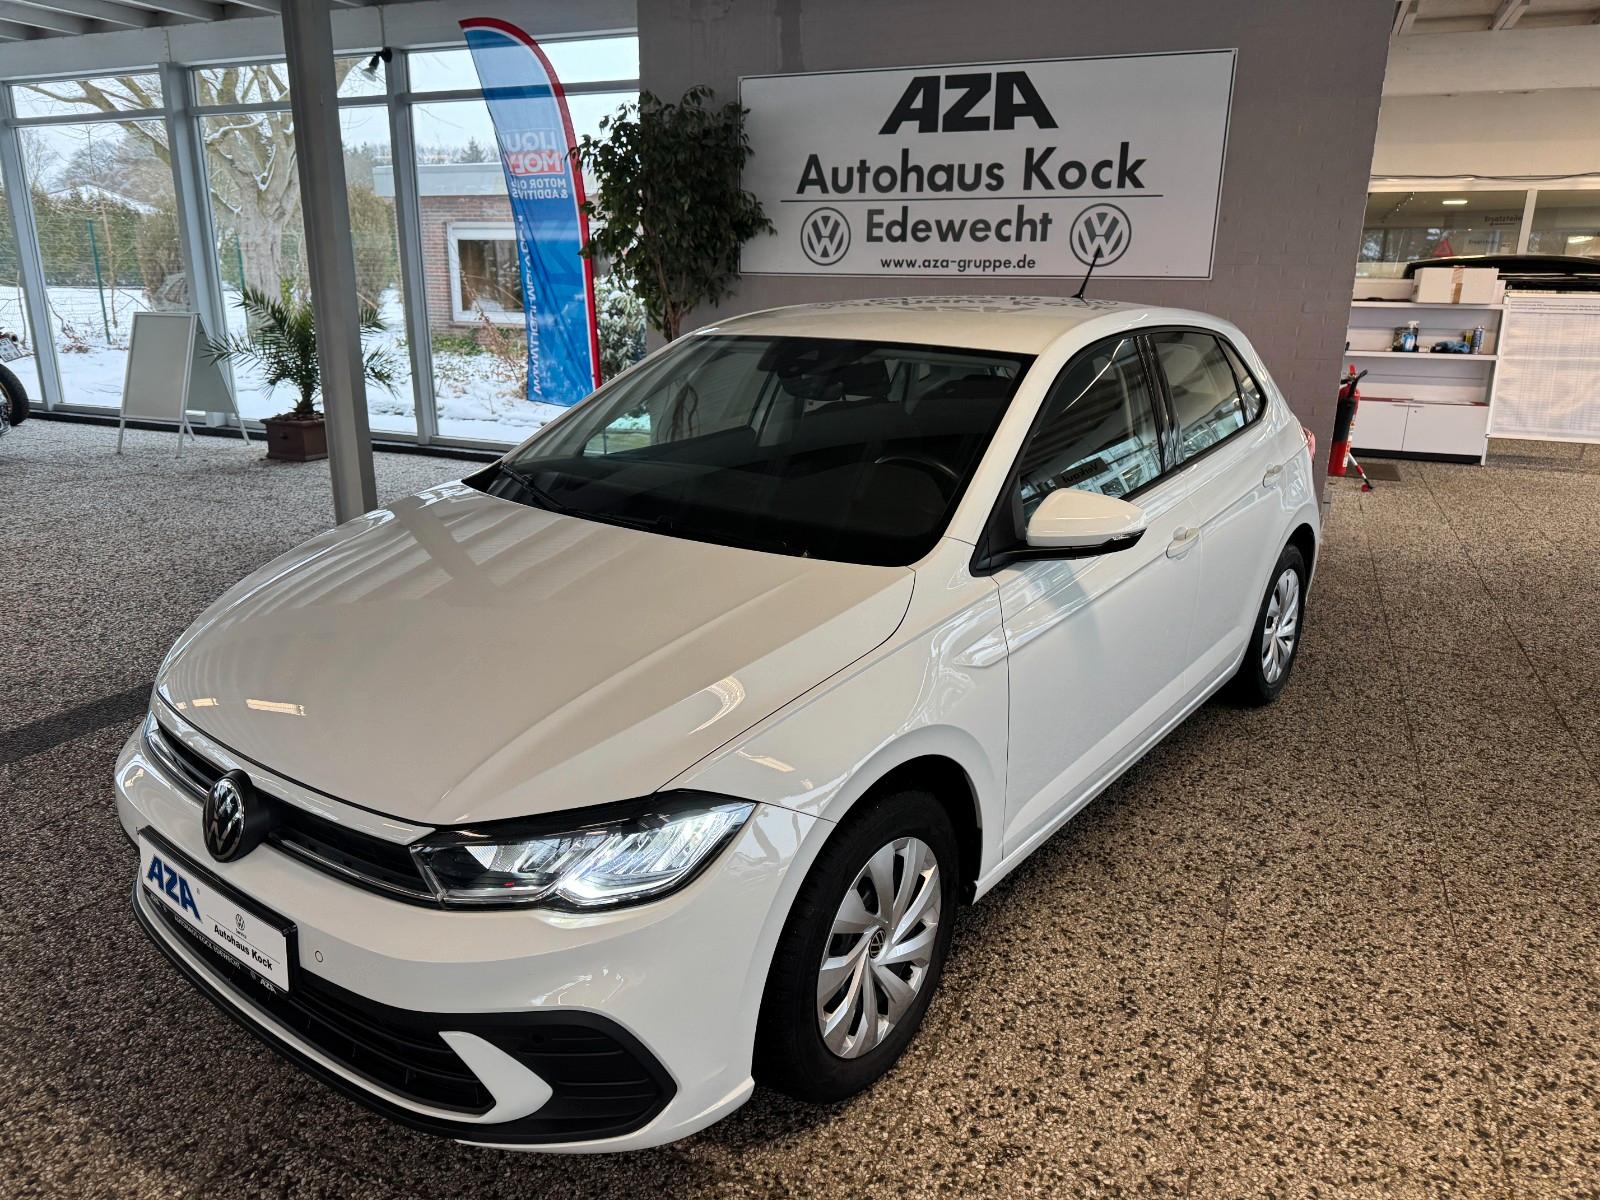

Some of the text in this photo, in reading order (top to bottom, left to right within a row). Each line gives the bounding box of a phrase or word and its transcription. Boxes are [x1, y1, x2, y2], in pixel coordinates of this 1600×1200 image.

[878, 70, 1059, 135] AZA
[796, 141, 1147, 195] Autohaus Kock
[865, 204, 1053, 244] Edewecht
[880, 254, 1036, 272] www.aza-gruppe.de
[146, 854, 203, 924] AZA
[214, 924, 250, 956] Autohaus
[251, 948, 273, 971] Kock
